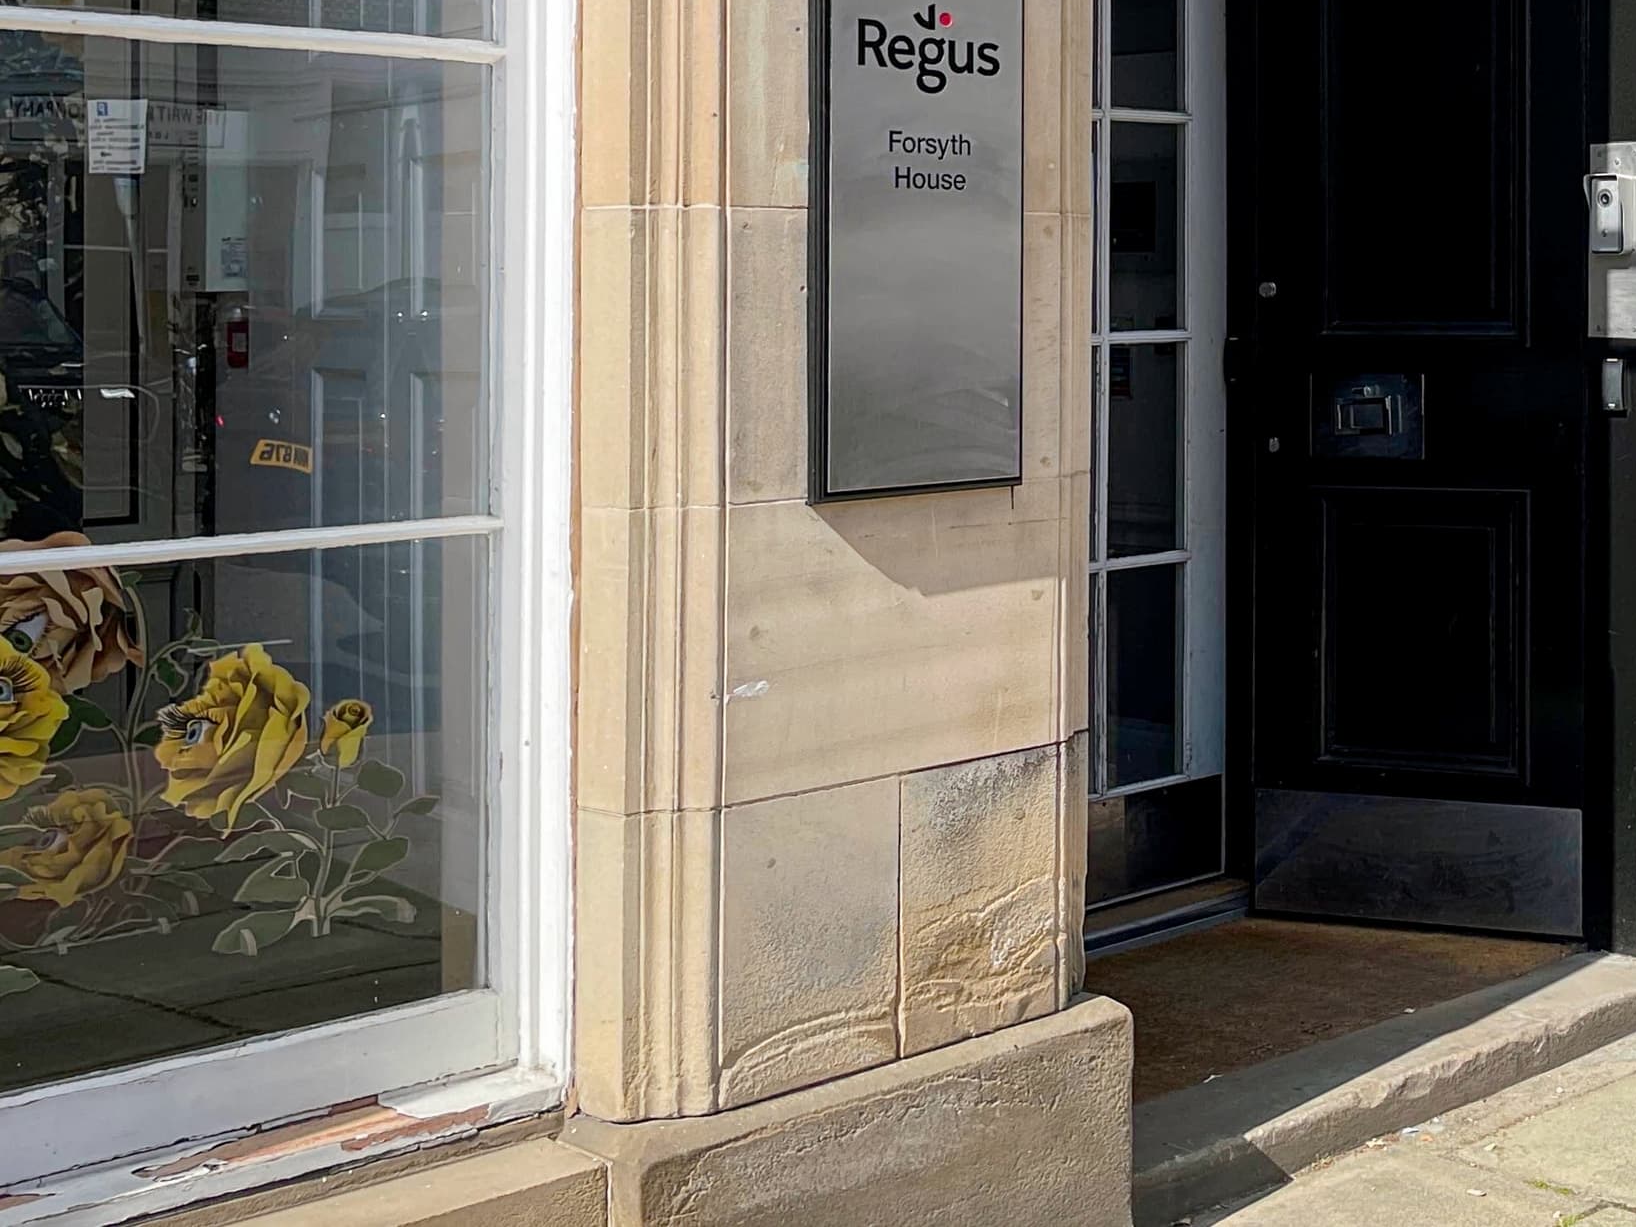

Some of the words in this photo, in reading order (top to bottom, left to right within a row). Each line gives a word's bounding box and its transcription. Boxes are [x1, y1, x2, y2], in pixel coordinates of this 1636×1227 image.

[856, 17, 1001, 94] Regus
[888, 130, 972, 161] Forsyth
[894, 166, 967, 191] House
